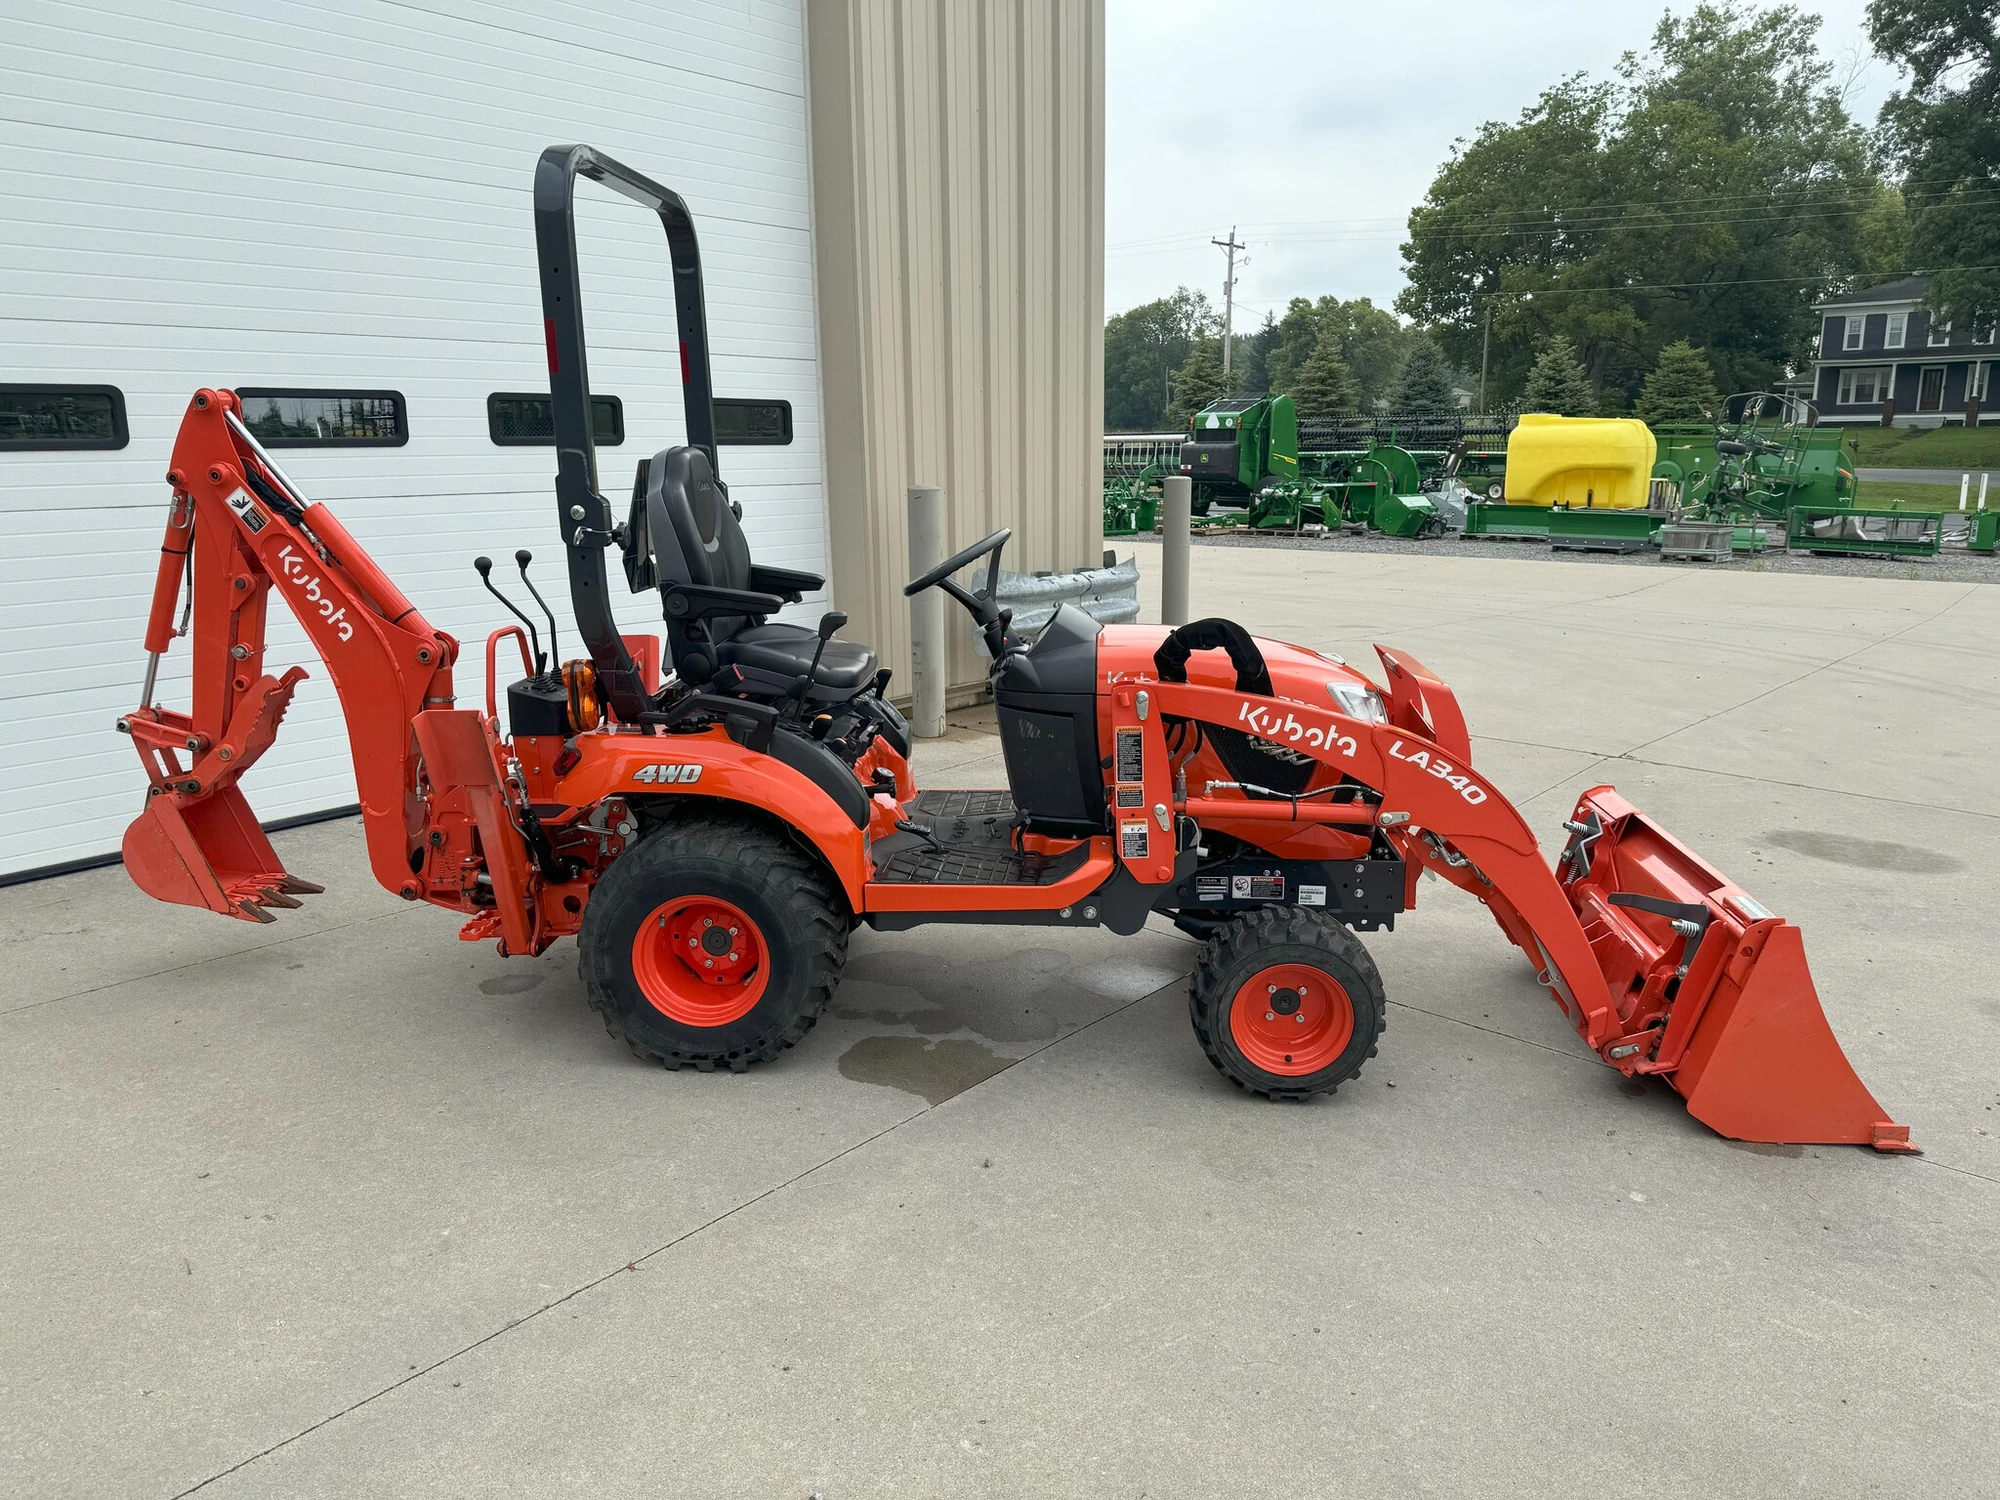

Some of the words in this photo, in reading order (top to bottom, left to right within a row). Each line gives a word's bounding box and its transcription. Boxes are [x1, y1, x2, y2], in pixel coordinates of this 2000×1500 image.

[278, 544, 354, 642] Kubota
[1238, 701, 1357, 758] Kubota
[632, 764, 703, 784] 4WD
[1388, 740, 1487, 805] LA340
